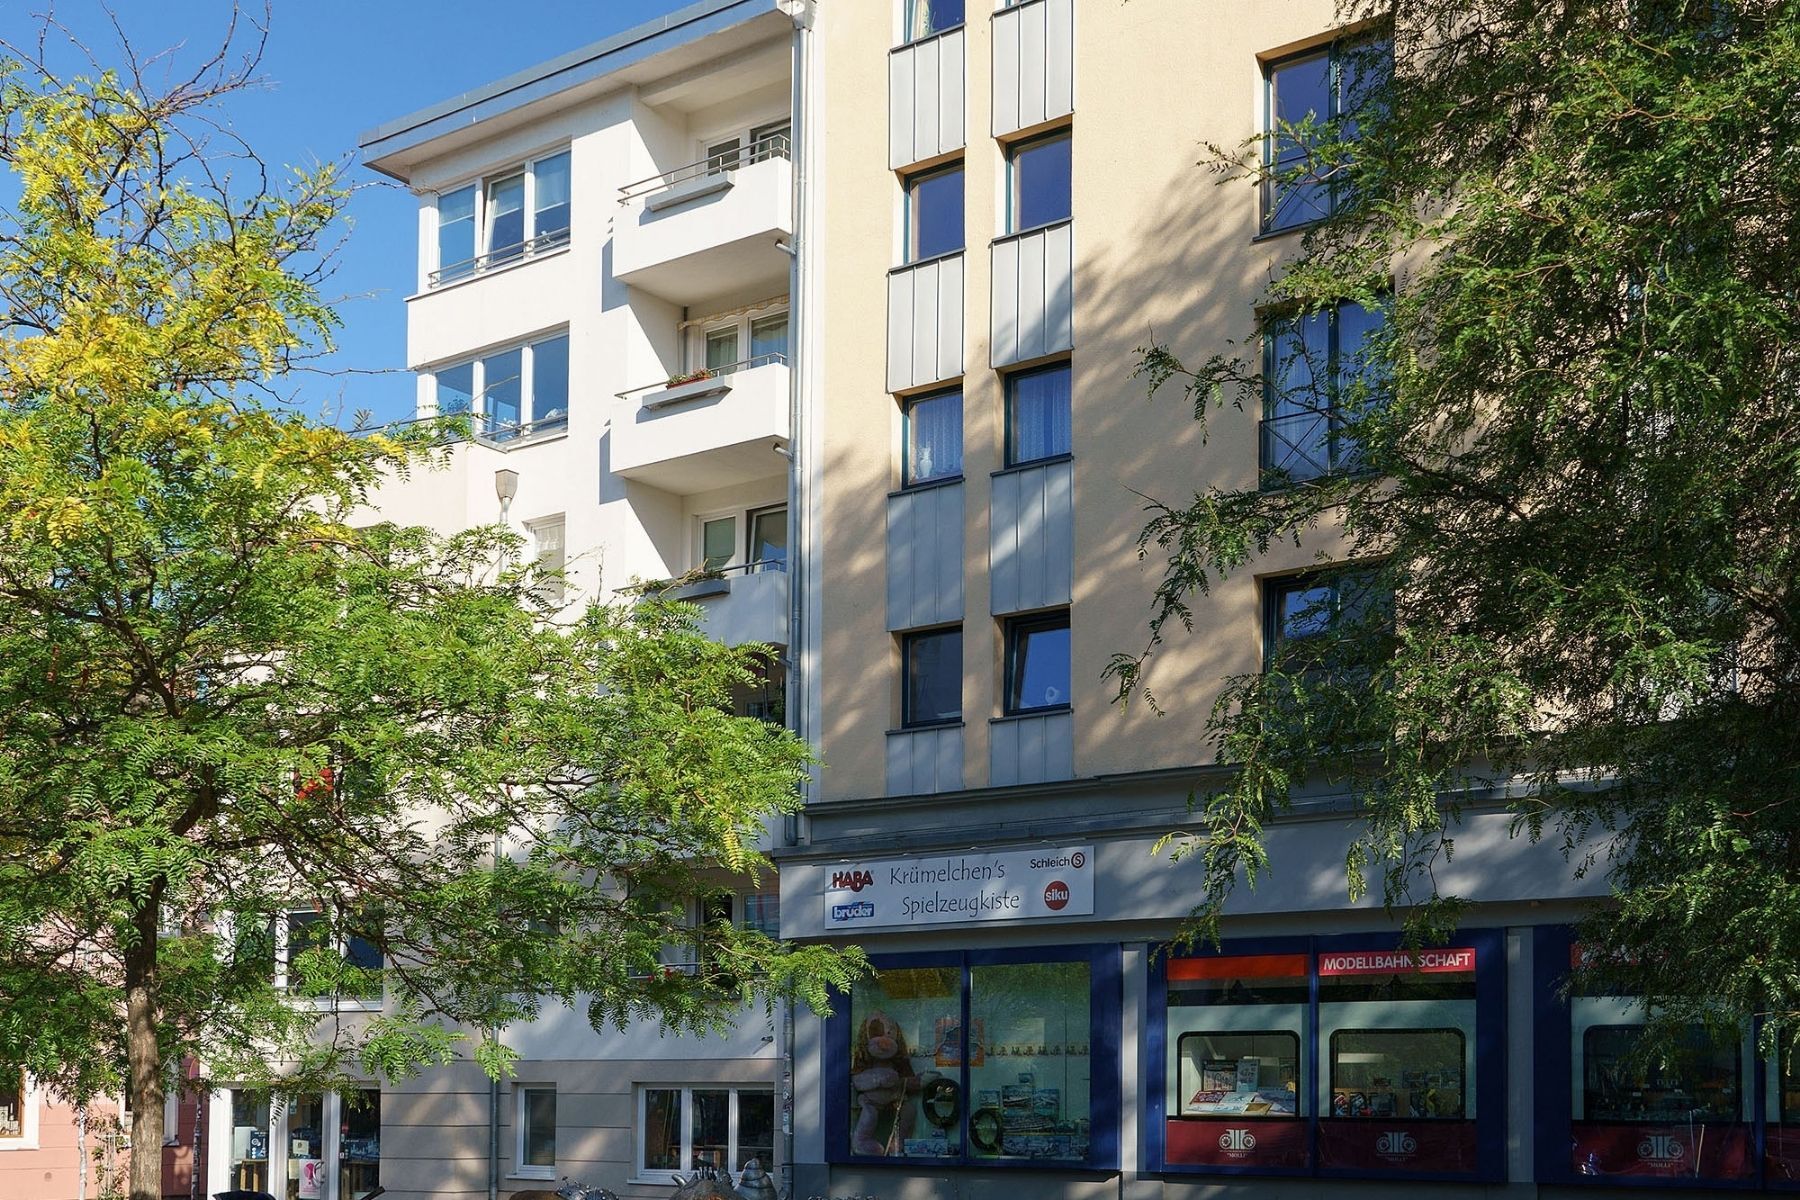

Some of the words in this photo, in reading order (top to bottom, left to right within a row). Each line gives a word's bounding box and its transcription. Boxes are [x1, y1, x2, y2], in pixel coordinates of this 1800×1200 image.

[1030, 856, 1070, 869] Schleich
[832, 870, 873, 892] HABA
[889, 859, 1005, 885] Krümelchen's
[1045, 889, 1068, 902] siku
[833, 904, 873, 919] bruder
[902, 890, 1020, 920] Spielzeugkiste
